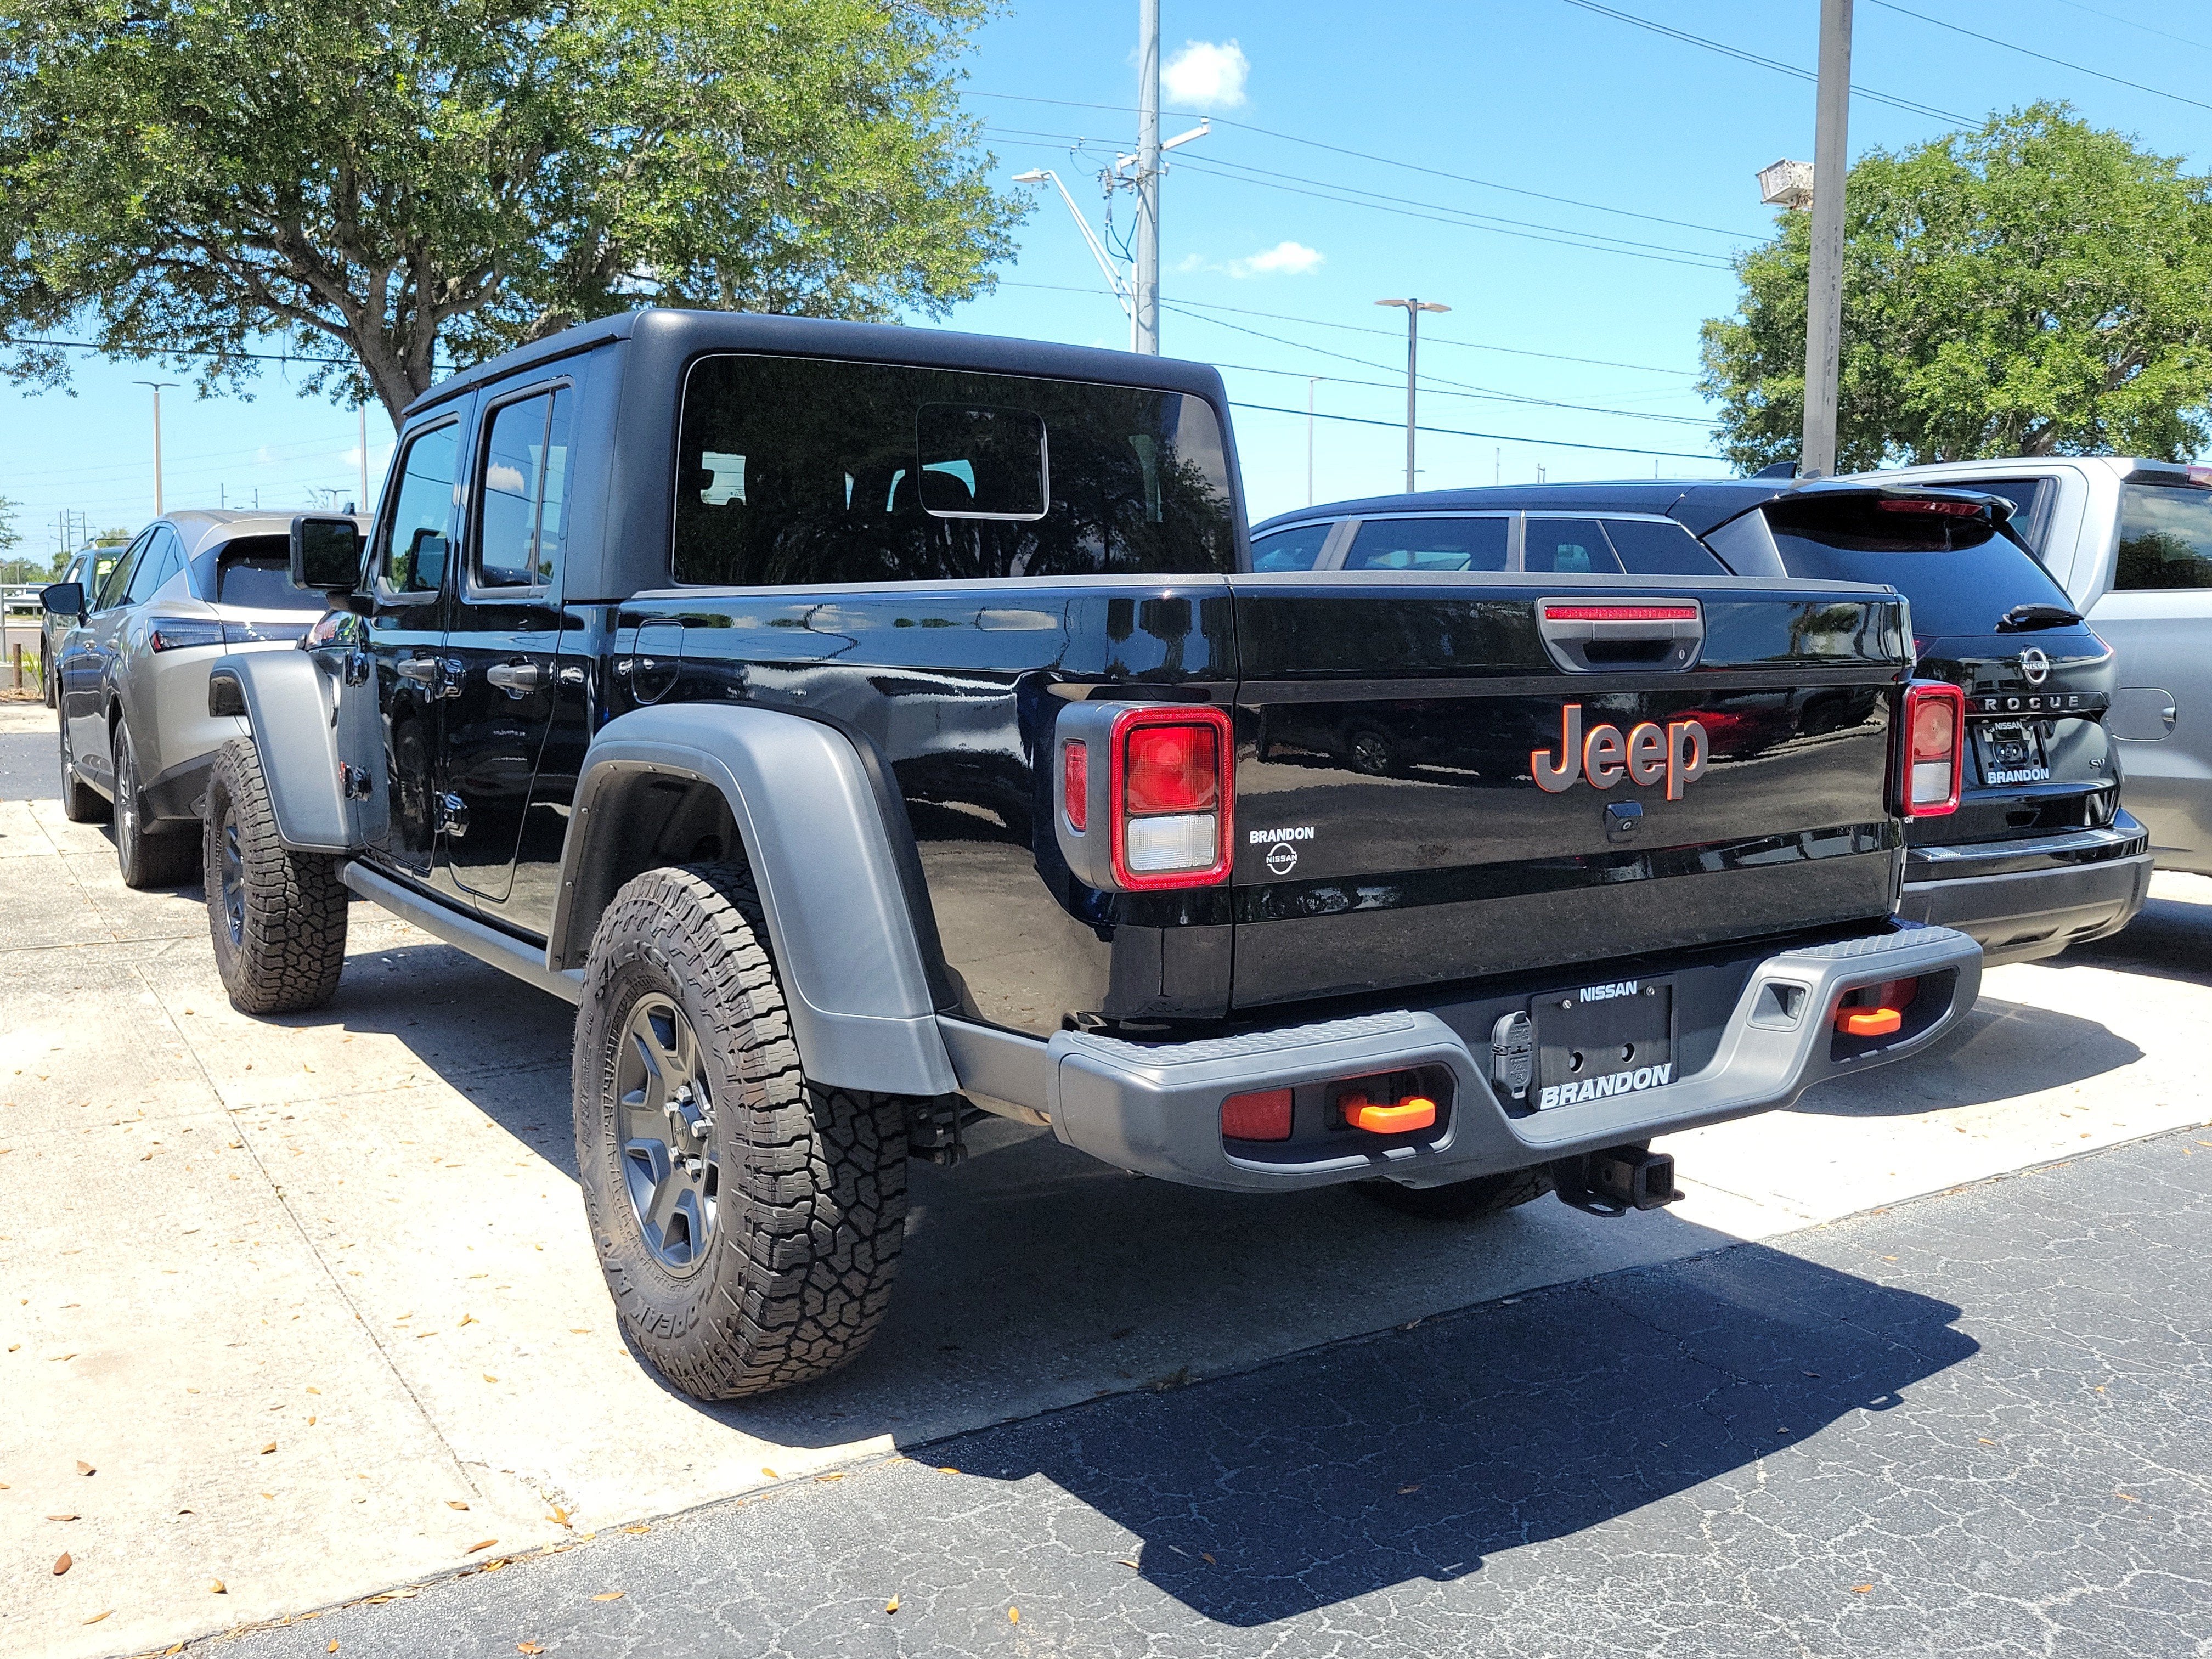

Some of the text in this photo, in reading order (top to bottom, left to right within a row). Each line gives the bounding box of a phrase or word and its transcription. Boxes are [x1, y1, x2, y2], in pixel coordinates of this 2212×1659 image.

[1984, 696, 2079, 710] ROGUE
[1995, 721, 2022, 730] NISSAN
[1531, 703, 1708, 800] Jeep
[2089, 759, 2105, 769] SV
[1988, 768, 2049, 784] BRANDON
[1250, 827, 1314, 844] BRANDON
[1266, 854, 1297, 864] NISSAN
[1579, 981, 1637, 1002] NISSAN
[1540, 1063, 1672, 1111] BRANDON
